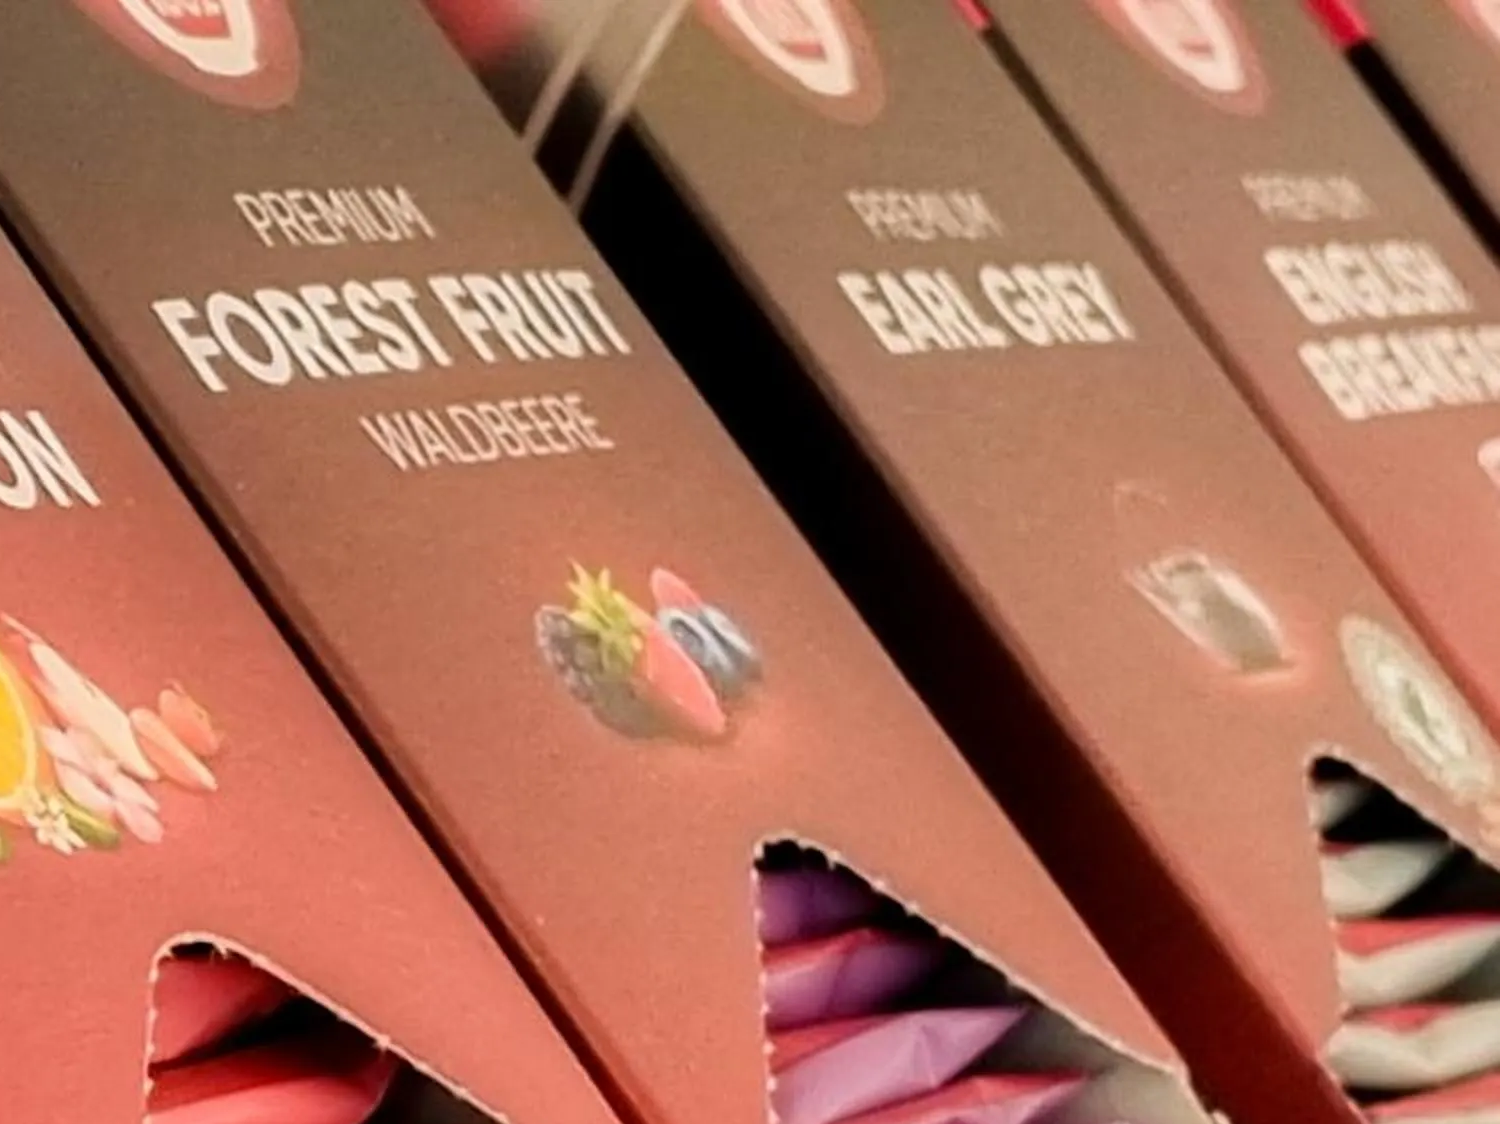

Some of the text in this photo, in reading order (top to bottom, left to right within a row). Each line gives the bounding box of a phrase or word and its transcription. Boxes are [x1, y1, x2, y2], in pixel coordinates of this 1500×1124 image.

[233, 185, 436, 248] PREMIUM
[836, 260, 1136, 354] EARL GREY
[1263, 240, 1474, 325] ENGLISH
[152, 270, 631, 393] FOREST FRUIT
[359, 394, 614, 471] WALDBEERE
